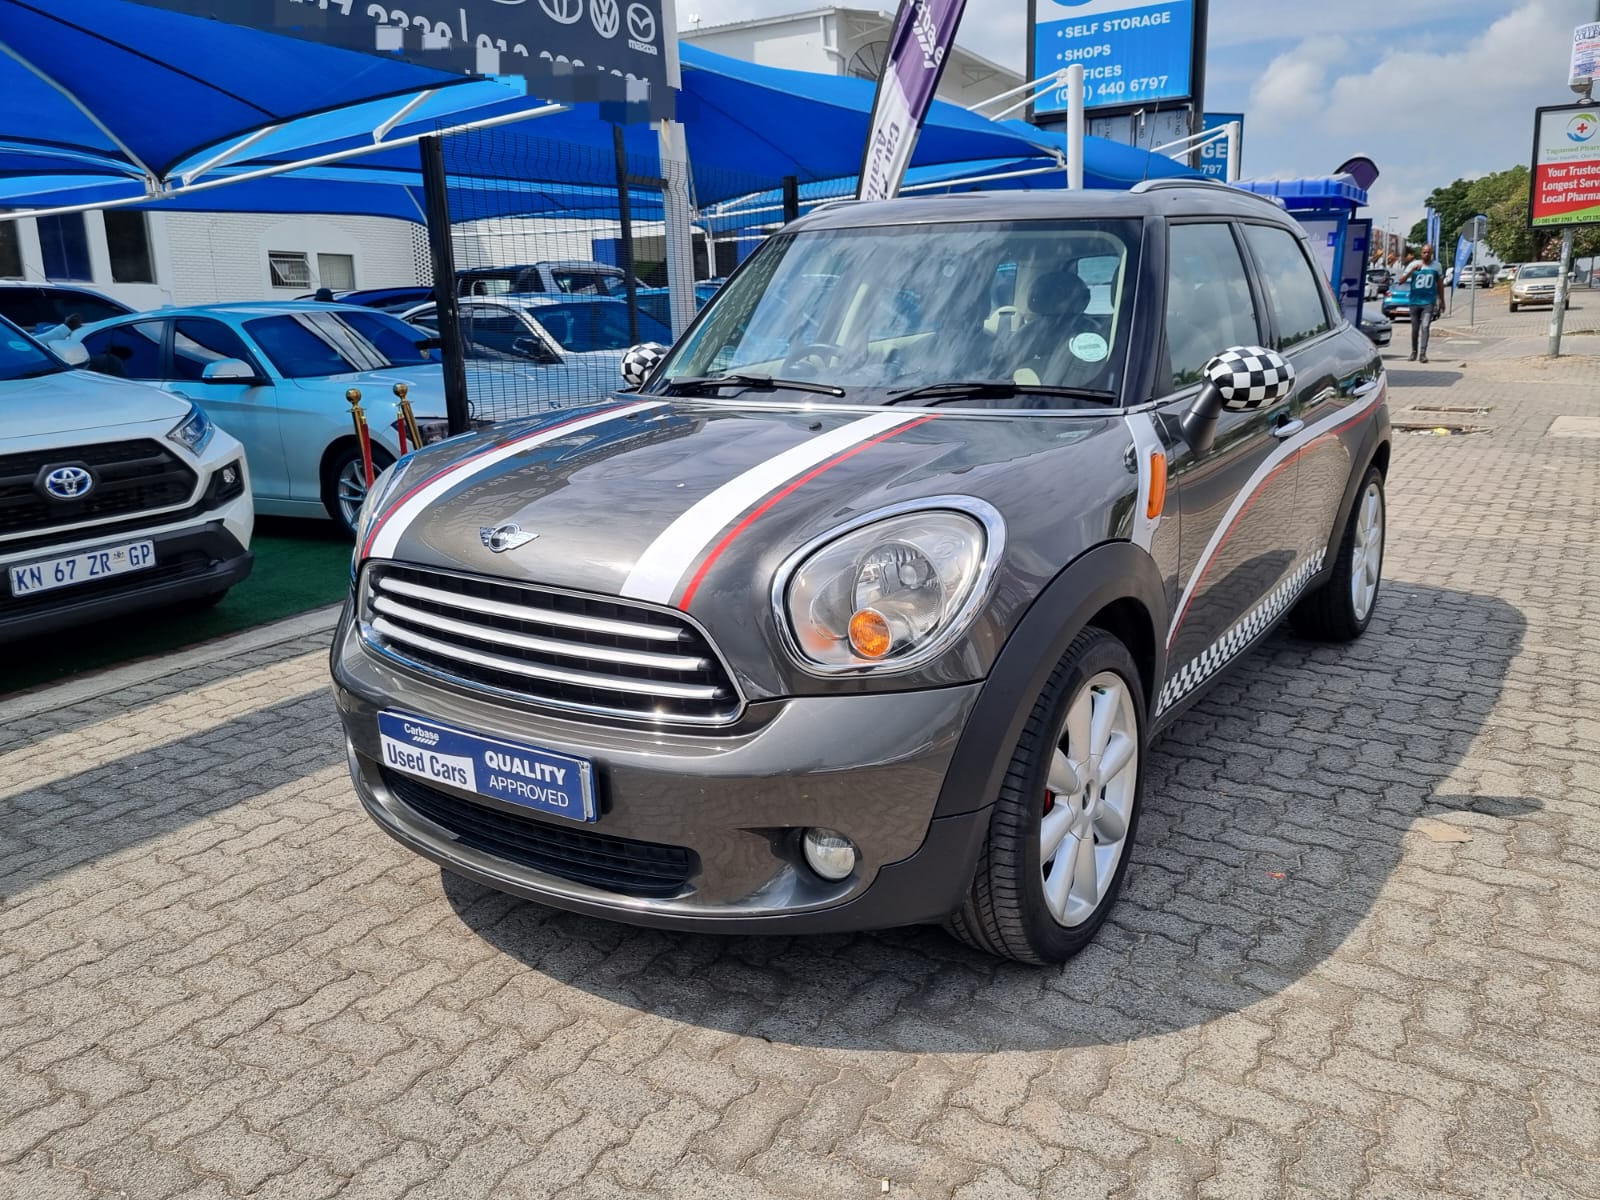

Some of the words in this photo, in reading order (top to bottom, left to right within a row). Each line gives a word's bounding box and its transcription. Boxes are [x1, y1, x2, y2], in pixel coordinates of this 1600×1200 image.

[1065, 22, 1099, 38] SELF
[1103, 11, 1171, 33] STORAGE
[628, 39, 658, 56] mazda
[1064, 44, 1111, 61] SHOPS
[1083, 64, 1123, 80] FICES
[1097, 81, 1125, 96] 440
[1130, 75, 1168, 92] 6797
[1201, 164, 1222, 175] 797
[1547, 167, 1567, 178] Your
[1542, 179, 1578, 193] Longest
[1579, 178, 1600, 188] Serv
[1542, 192, 1566, 204] Local
[15, 566, 43, 591] KN
[54, 559, 76, 583] 67
[88, 552, 112, 576] ZR
[129, 544, 151, 566] GP
[404, 722, 440, 742] Carbase
[386, 743, 425, 771] Used
[429, 756, 468, 785] Cars
[484, 750, 567, 786] QUALITY
[489, 774, 569, 808] APPROVED
